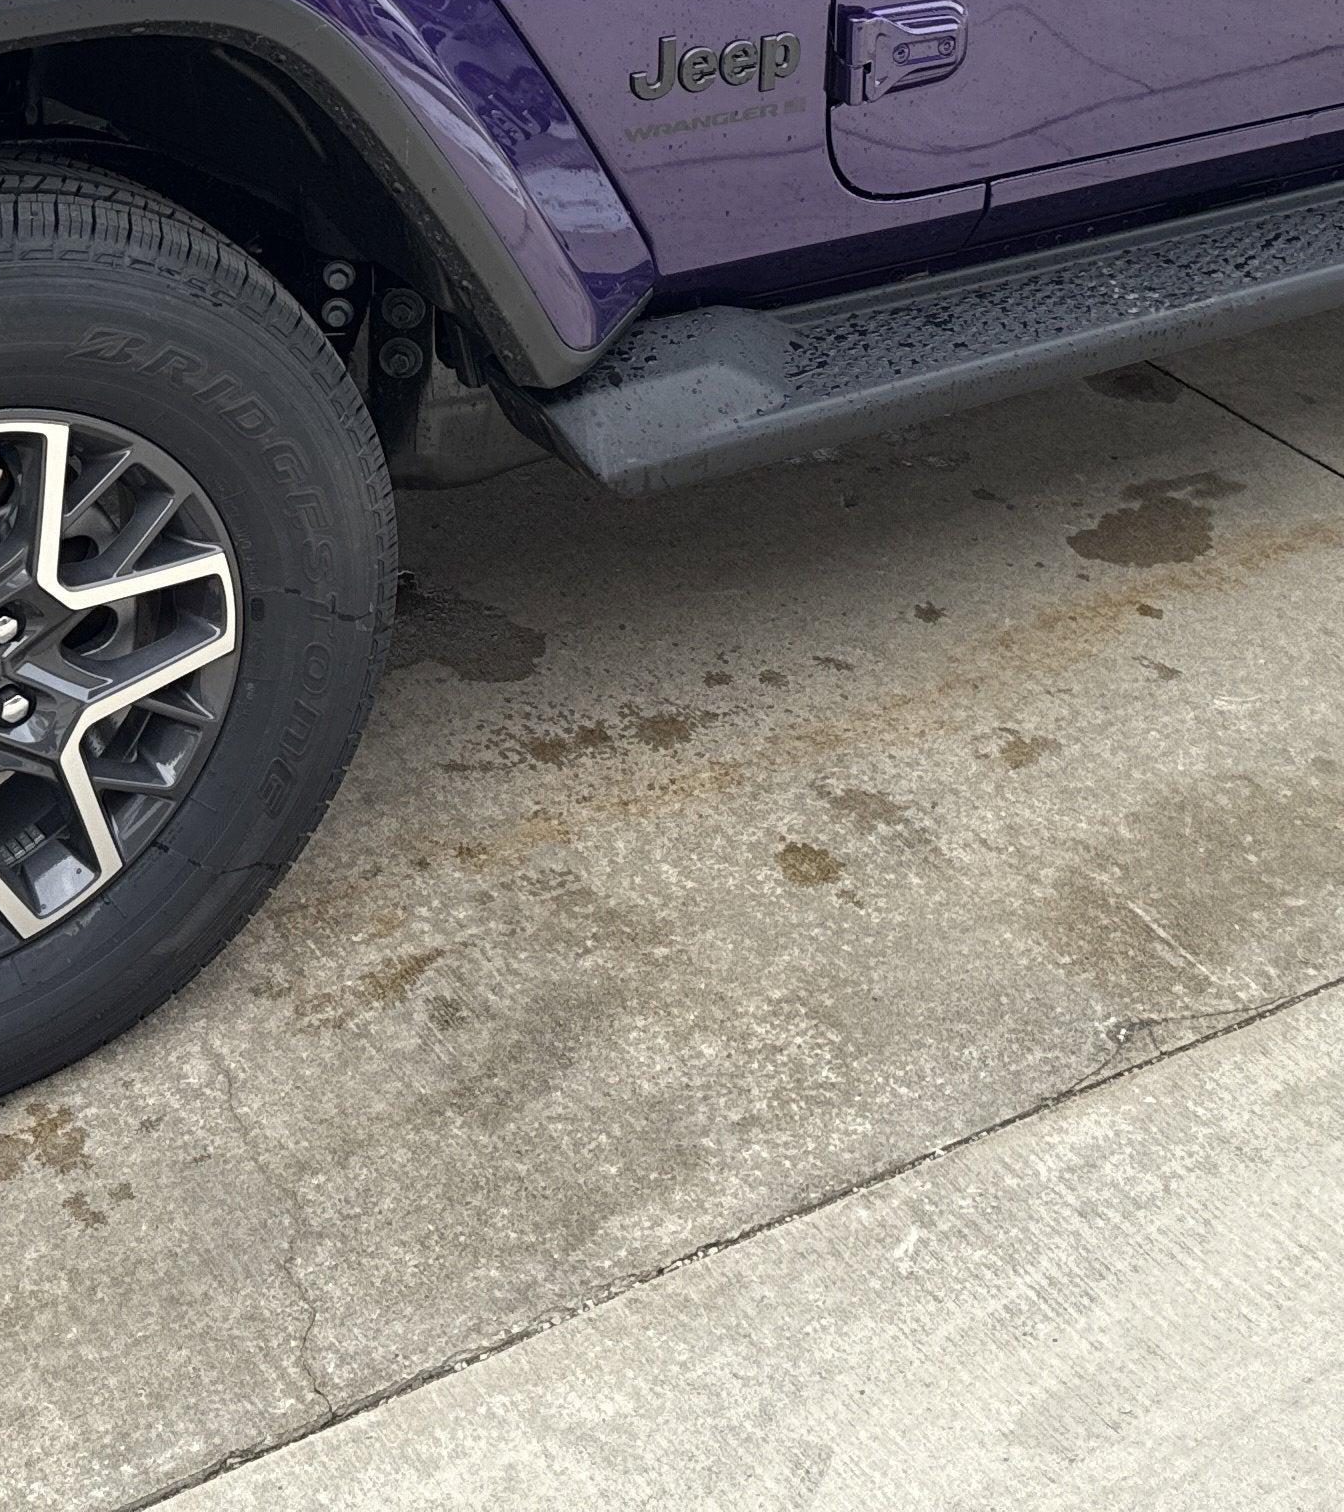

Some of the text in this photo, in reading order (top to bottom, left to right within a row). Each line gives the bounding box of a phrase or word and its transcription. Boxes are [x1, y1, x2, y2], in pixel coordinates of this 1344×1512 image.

[629, 31, 801, 101] Jeep
[624, 102, 778, 143] WRANGLER
[64, 327, 337, 819] BRIDGESTONE
